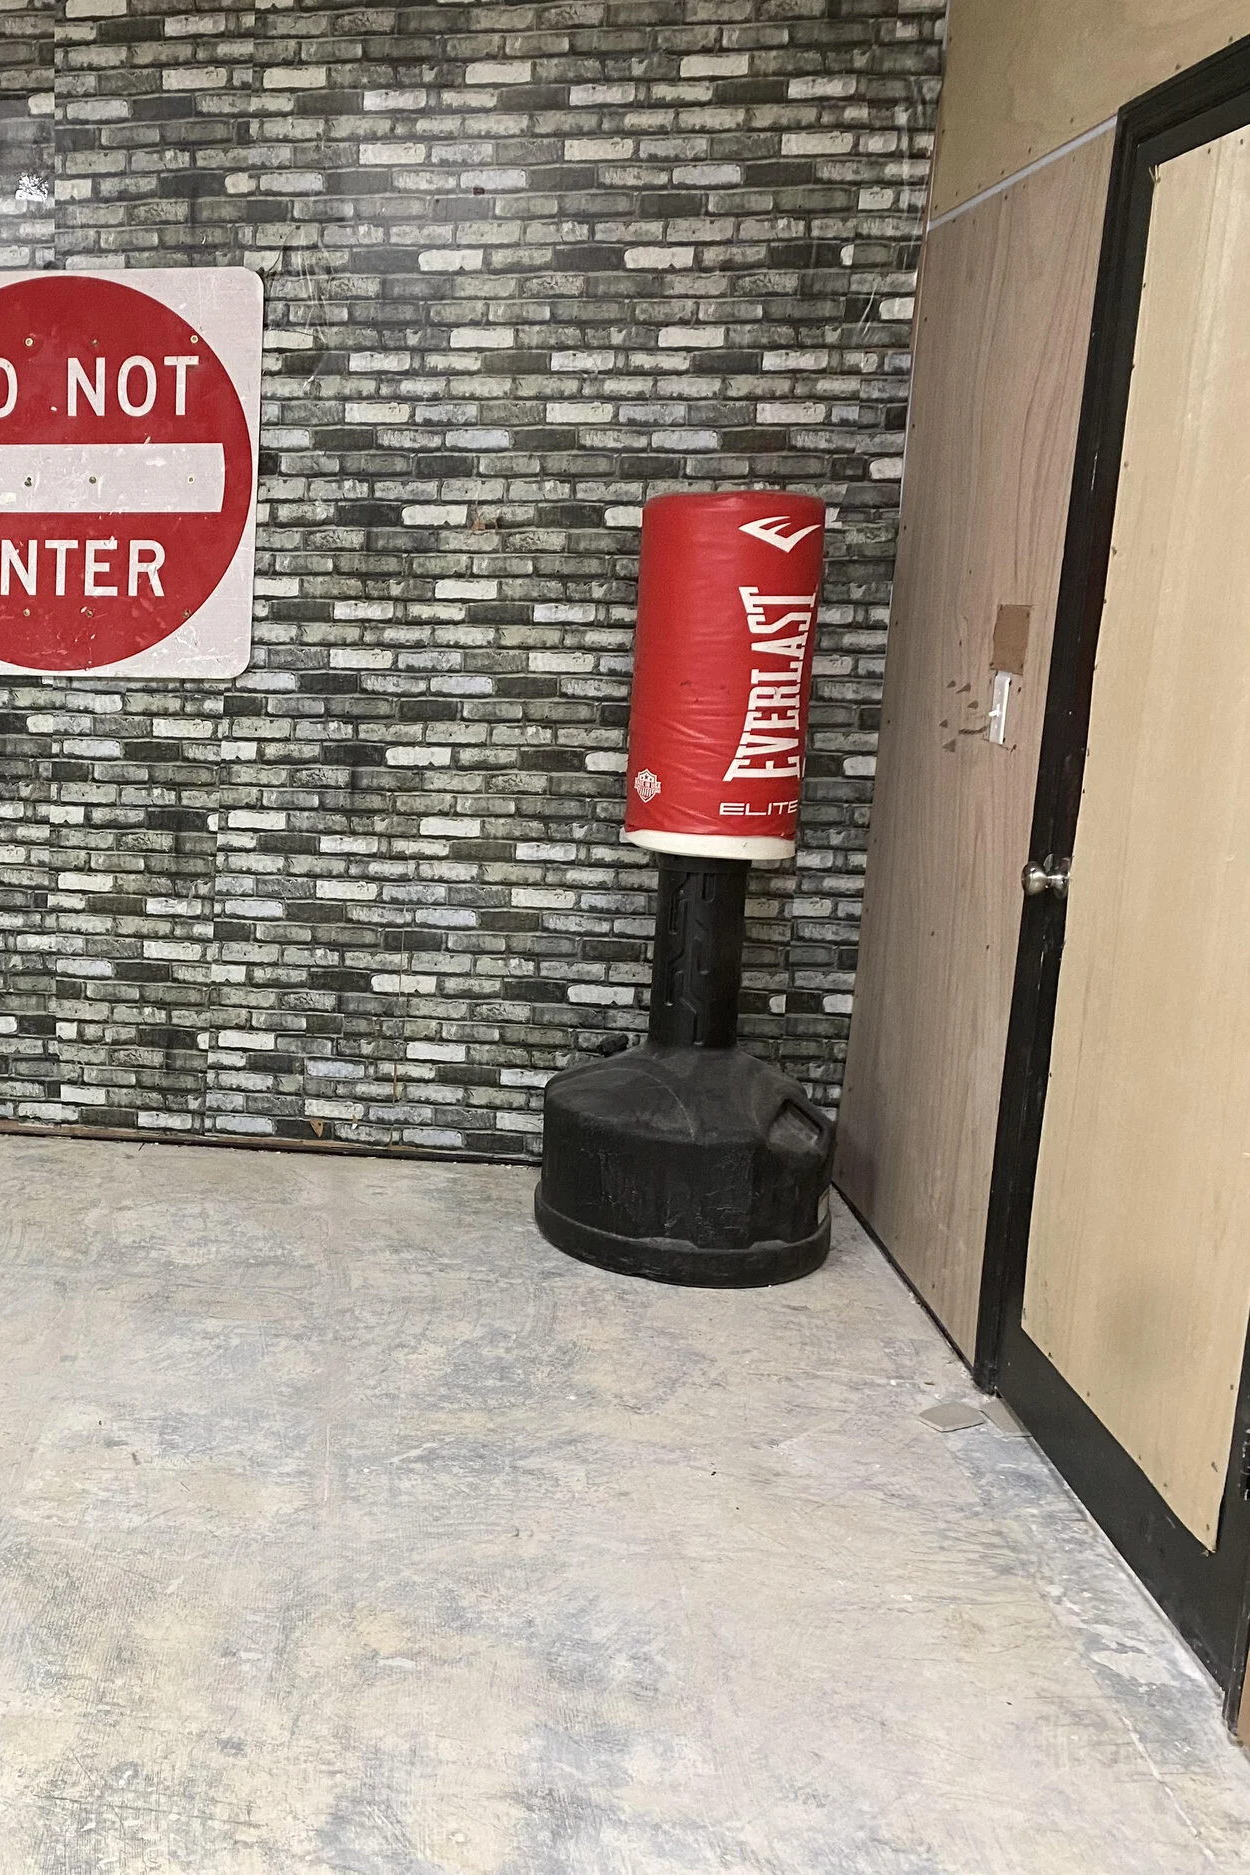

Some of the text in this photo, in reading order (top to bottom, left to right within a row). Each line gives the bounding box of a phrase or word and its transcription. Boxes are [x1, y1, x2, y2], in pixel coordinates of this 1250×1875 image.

[67, 355, 200, 417] NOT
[722, 586, 816, 782] EVERLAST
[719, 799, 799, 816] ELITE
